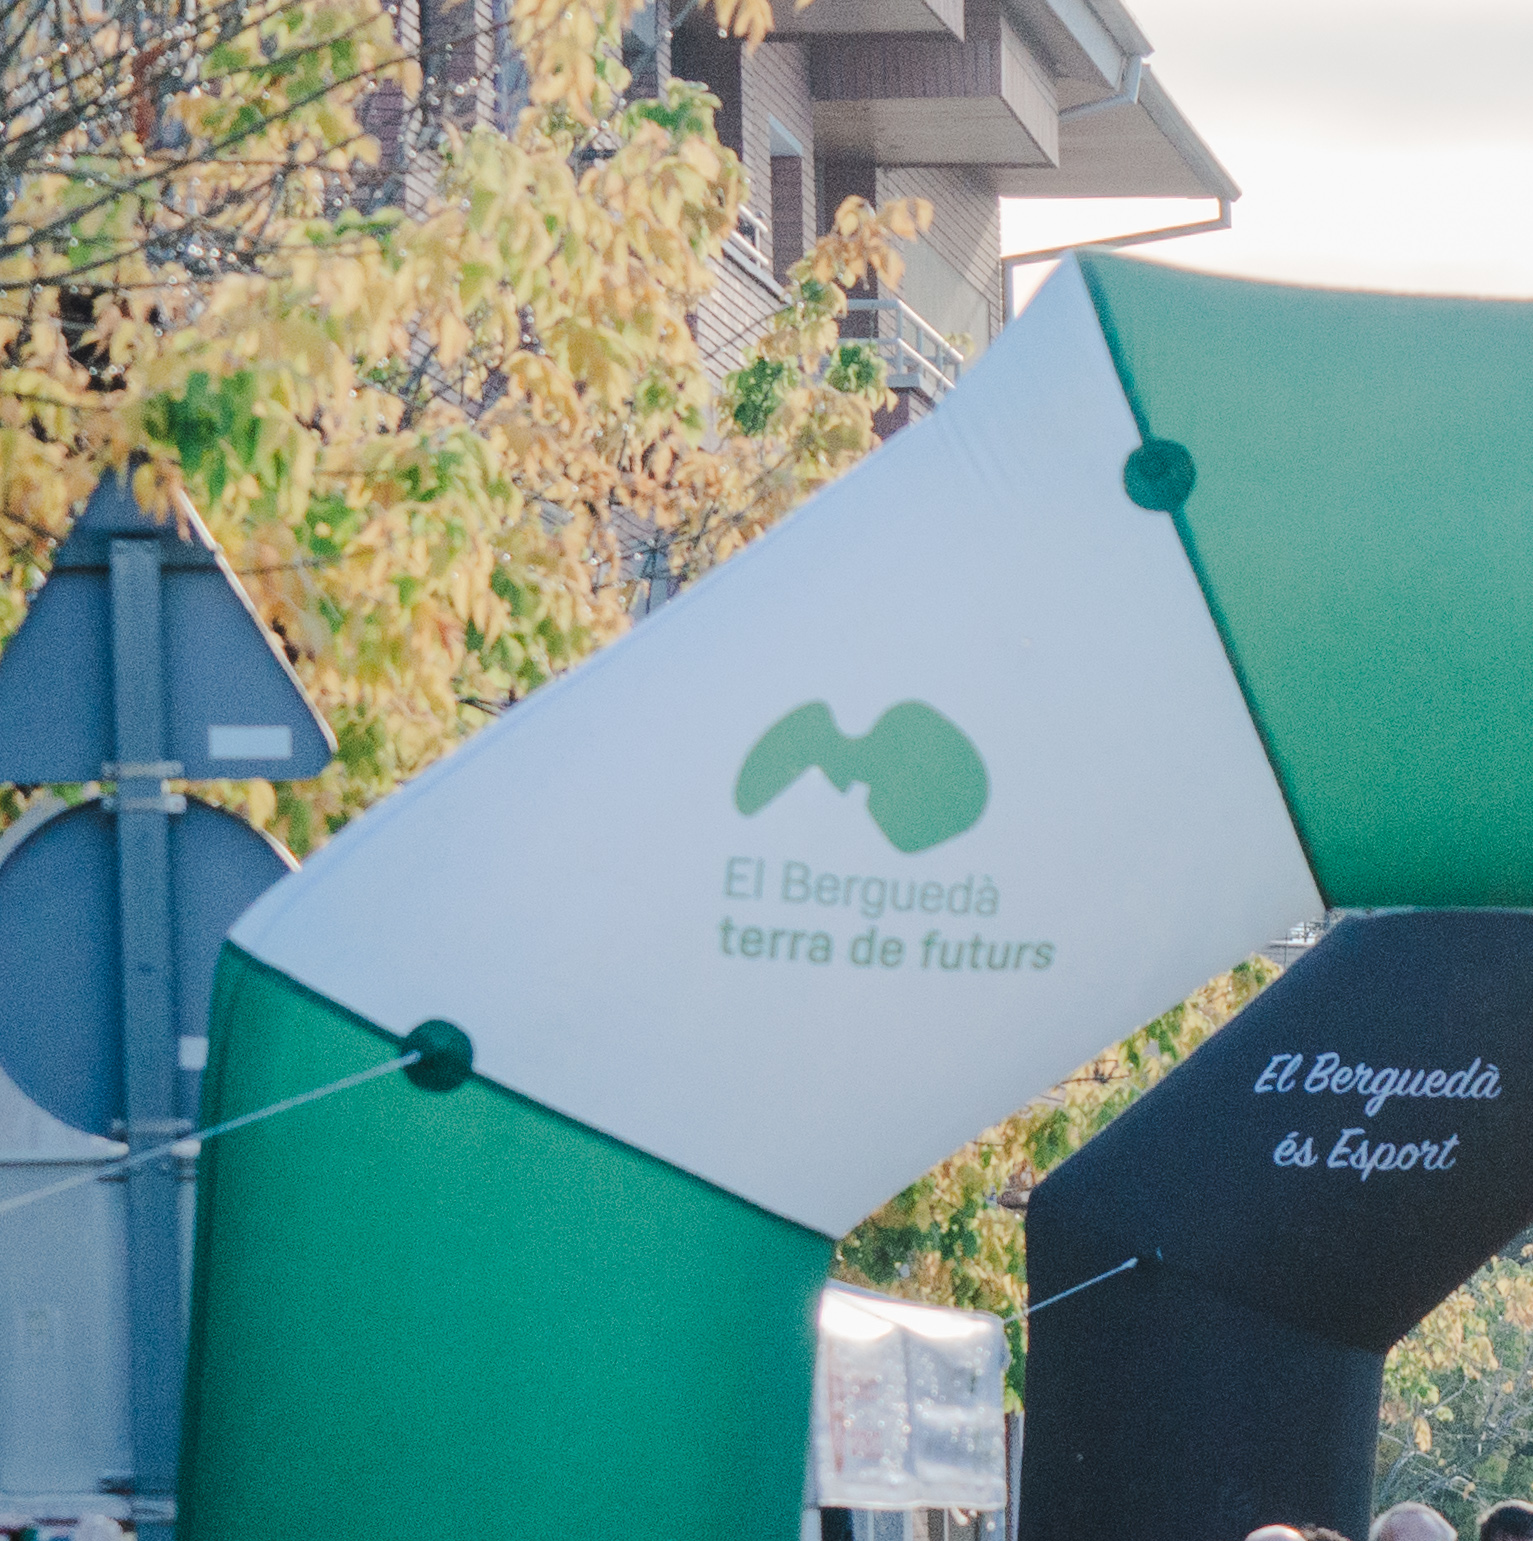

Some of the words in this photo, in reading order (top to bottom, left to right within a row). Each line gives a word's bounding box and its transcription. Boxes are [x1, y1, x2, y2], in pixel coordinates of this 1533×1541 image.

[722, 856, 765, 899] El
[781, 859, 1000, 920] Berguedà
[718, 915, 833, 965] terra
[849, 925, 905, 969] de
[921, 929, 1055, 971] futurs
[1253, 1053, 1304, 1094] El
[1304, 1051, 1502, 1118] Berguedà
[1272, 1130, 1319, 1168] és
[1325, 1126, 1460, 1182] Esport
